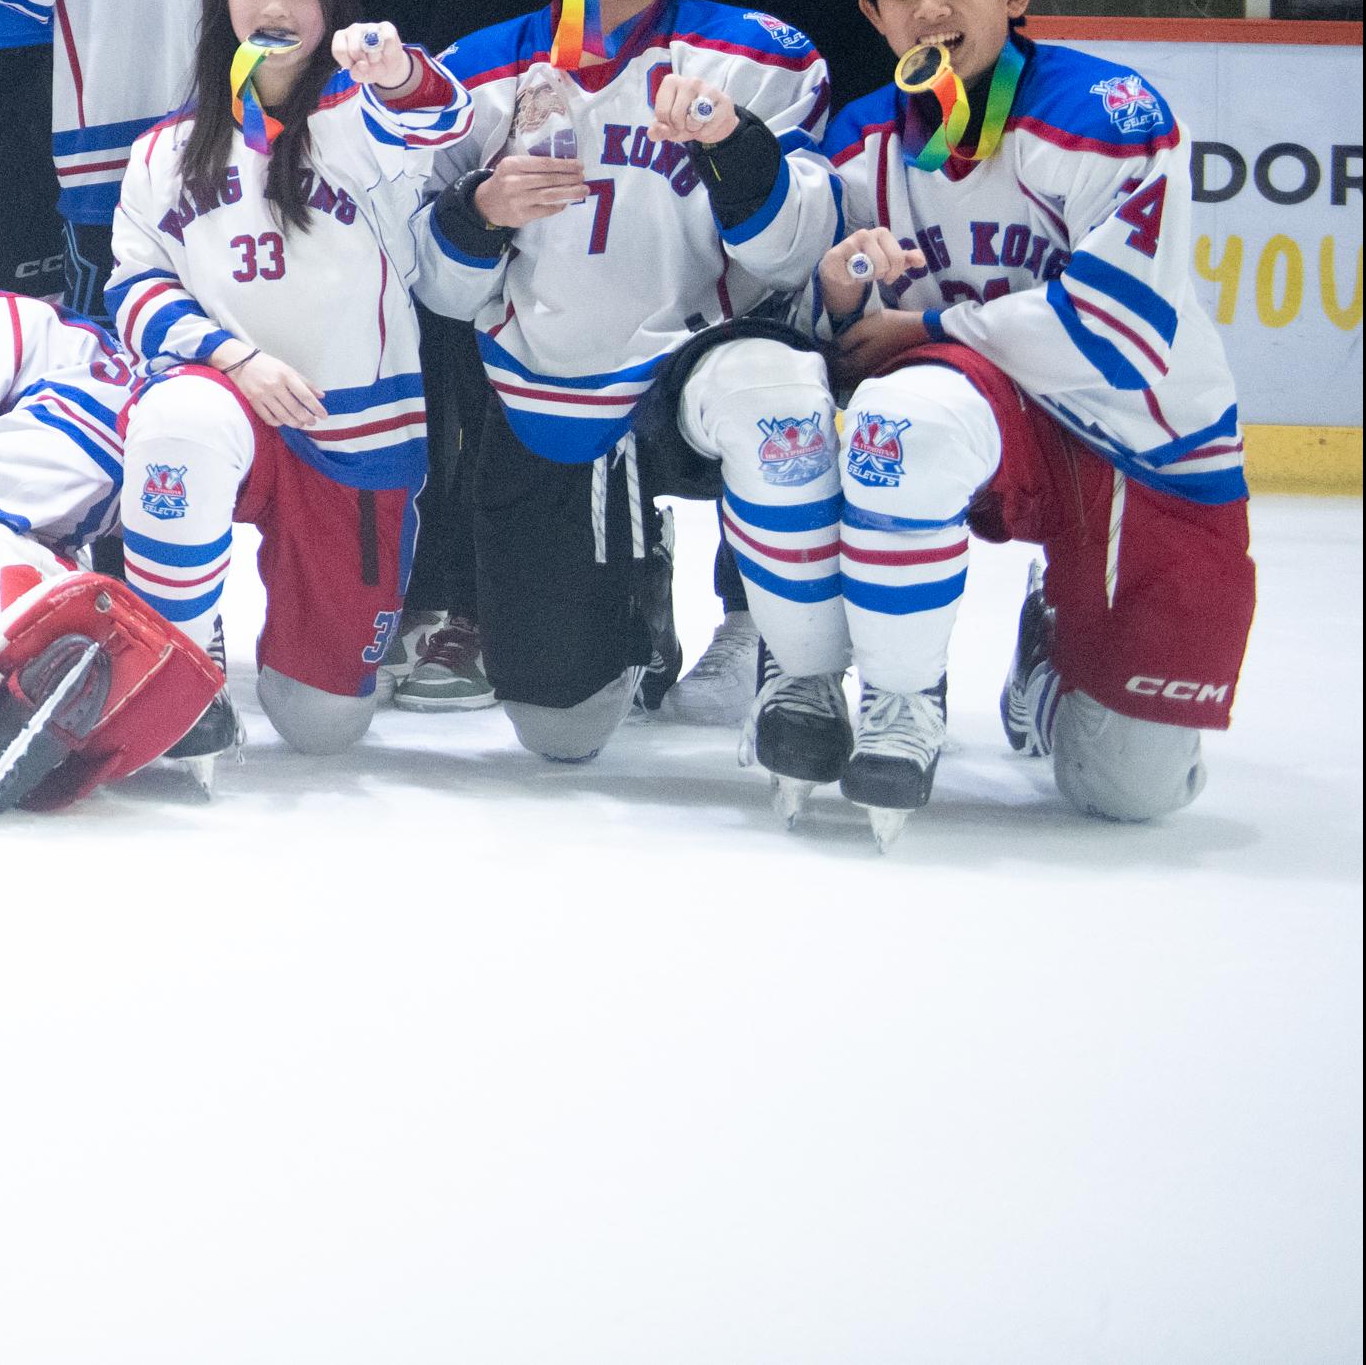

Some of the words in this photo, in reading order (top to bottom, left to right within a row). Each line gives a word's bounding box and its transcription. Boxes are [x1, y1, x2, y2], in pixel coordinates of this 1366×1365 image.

[570, 178, 616, 255] 7
[14, 253, 65, 279] CC
[230, 230, 286, 284] 33
[846, 466, 897, 485] SELECTS
[143, 503, 186, 518] SELECTS
[1124, 675, 1229, 703] CCM
